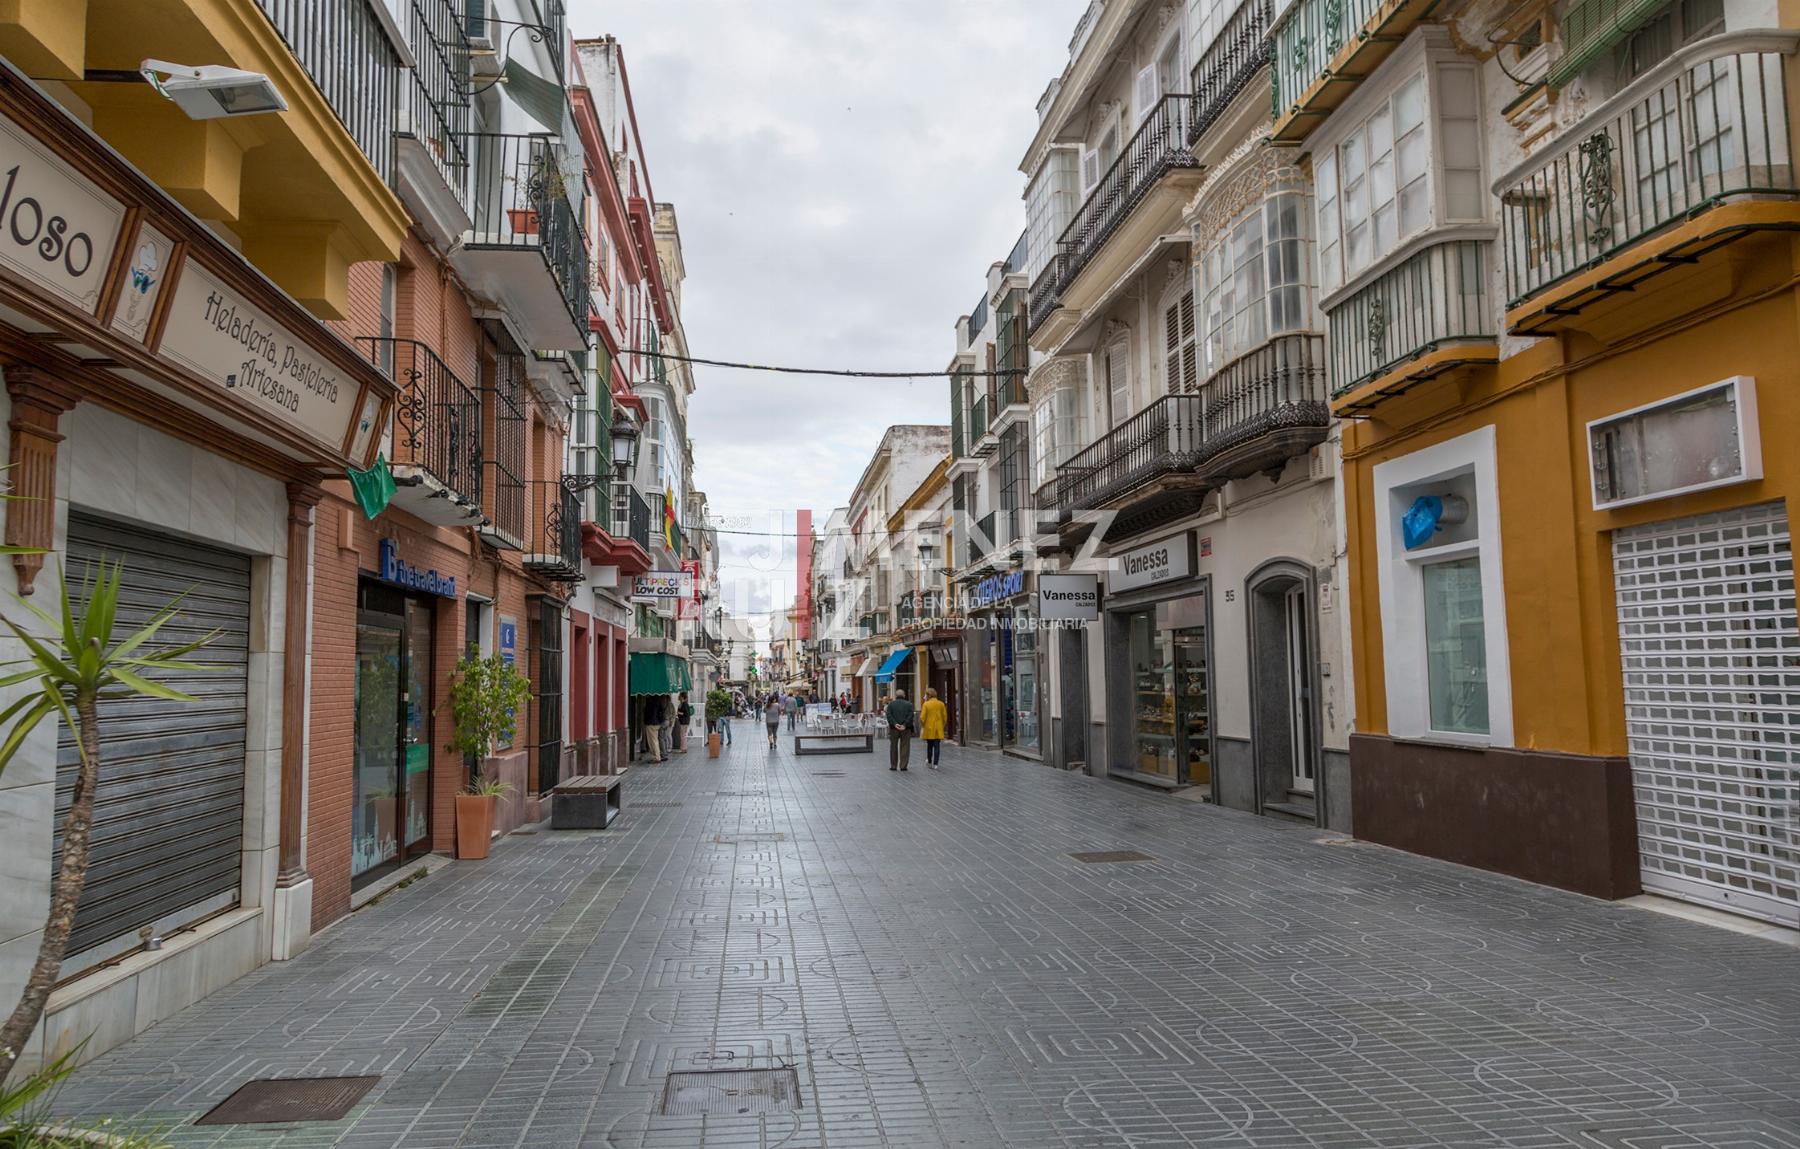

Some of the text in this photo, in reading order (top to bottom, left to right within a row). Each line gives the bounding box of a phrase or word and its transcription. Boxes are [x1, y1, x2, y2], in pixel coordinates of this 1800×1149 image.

[204, 290, 338, 404] Heladería, Pastelería
[239, 358, 300, 413] Artesana
[1123, 548, 1168, 576] Vanessa
[635, 586, 680, 595] LOW COST
[1043, 590, 1096, 601] Vanessa
